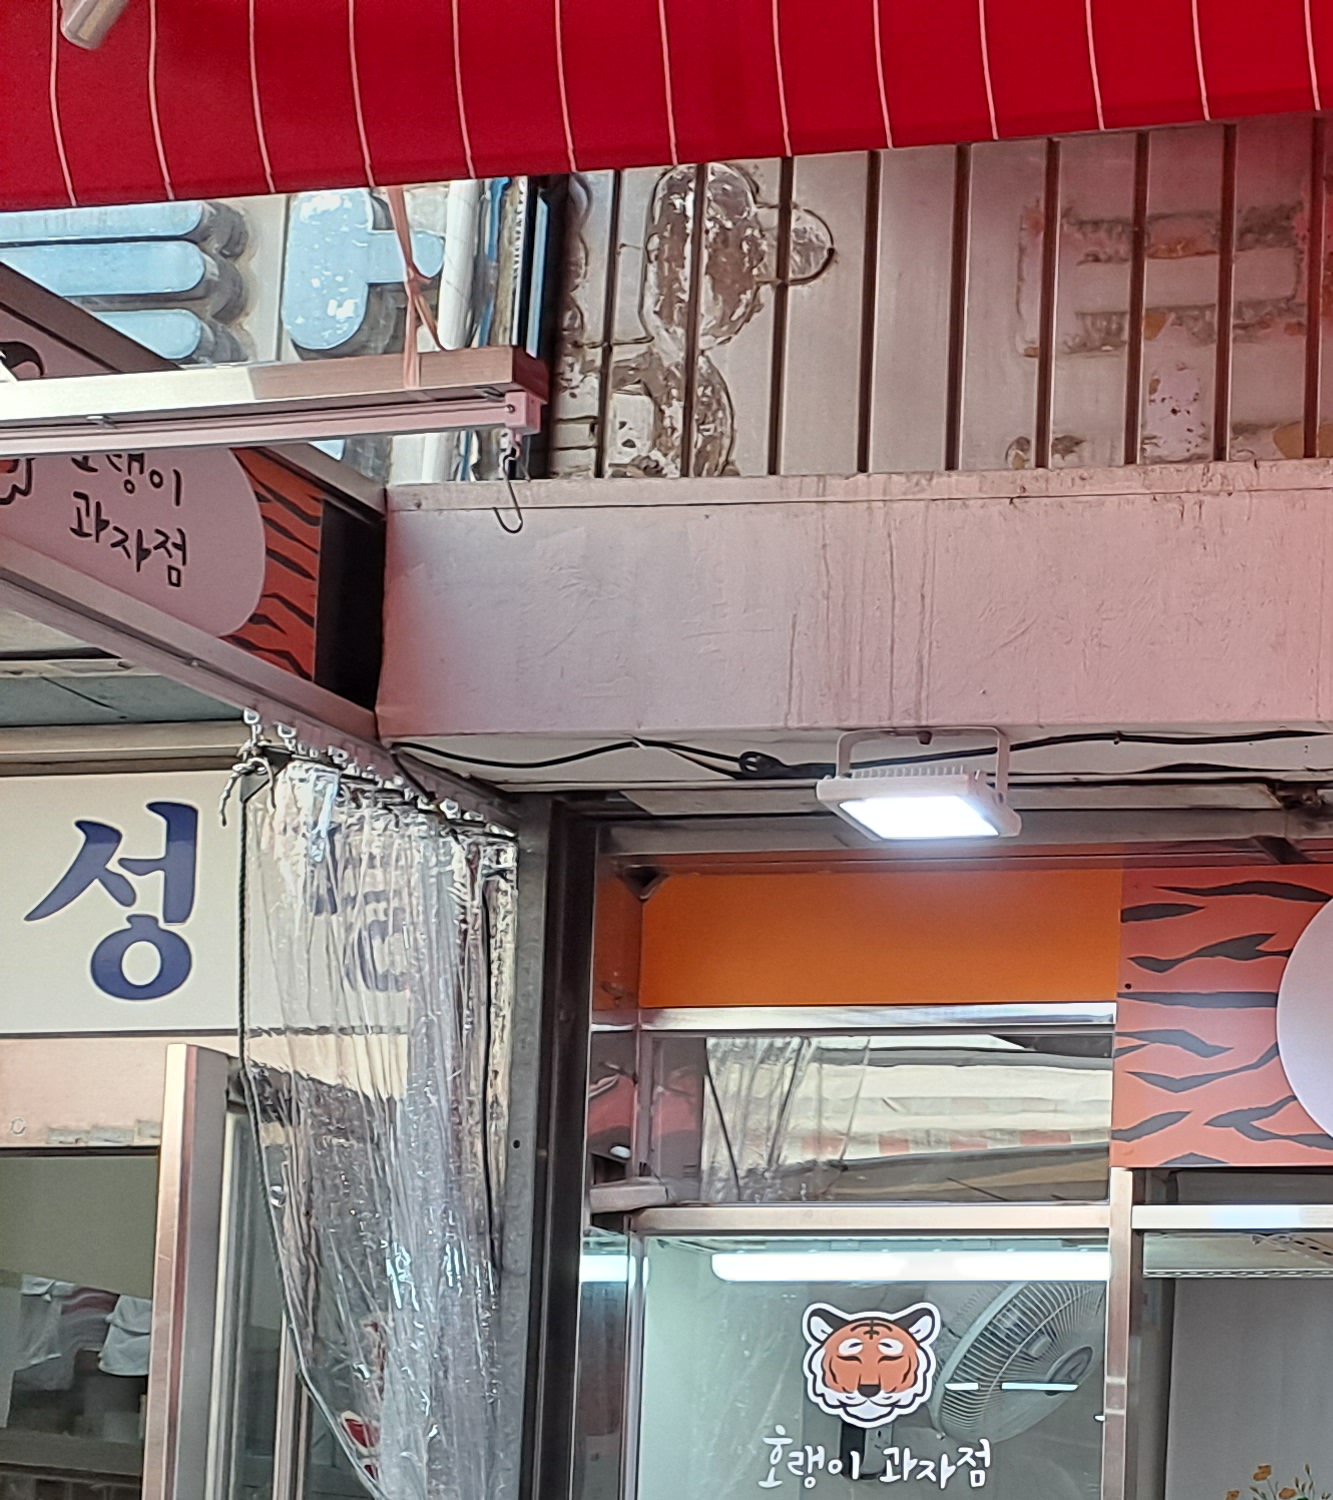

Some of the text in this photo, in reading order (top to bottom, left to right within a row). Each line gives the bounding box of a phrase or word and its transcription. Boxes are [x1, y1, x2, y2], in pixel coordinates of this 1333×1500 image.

[71, 453, 182, 507] 랭이
[69, 490, 187, 588] 과자점
[24, 801, 199, 1000] 성
[758, 1424, 992, 1489] 호랭이 과자점
